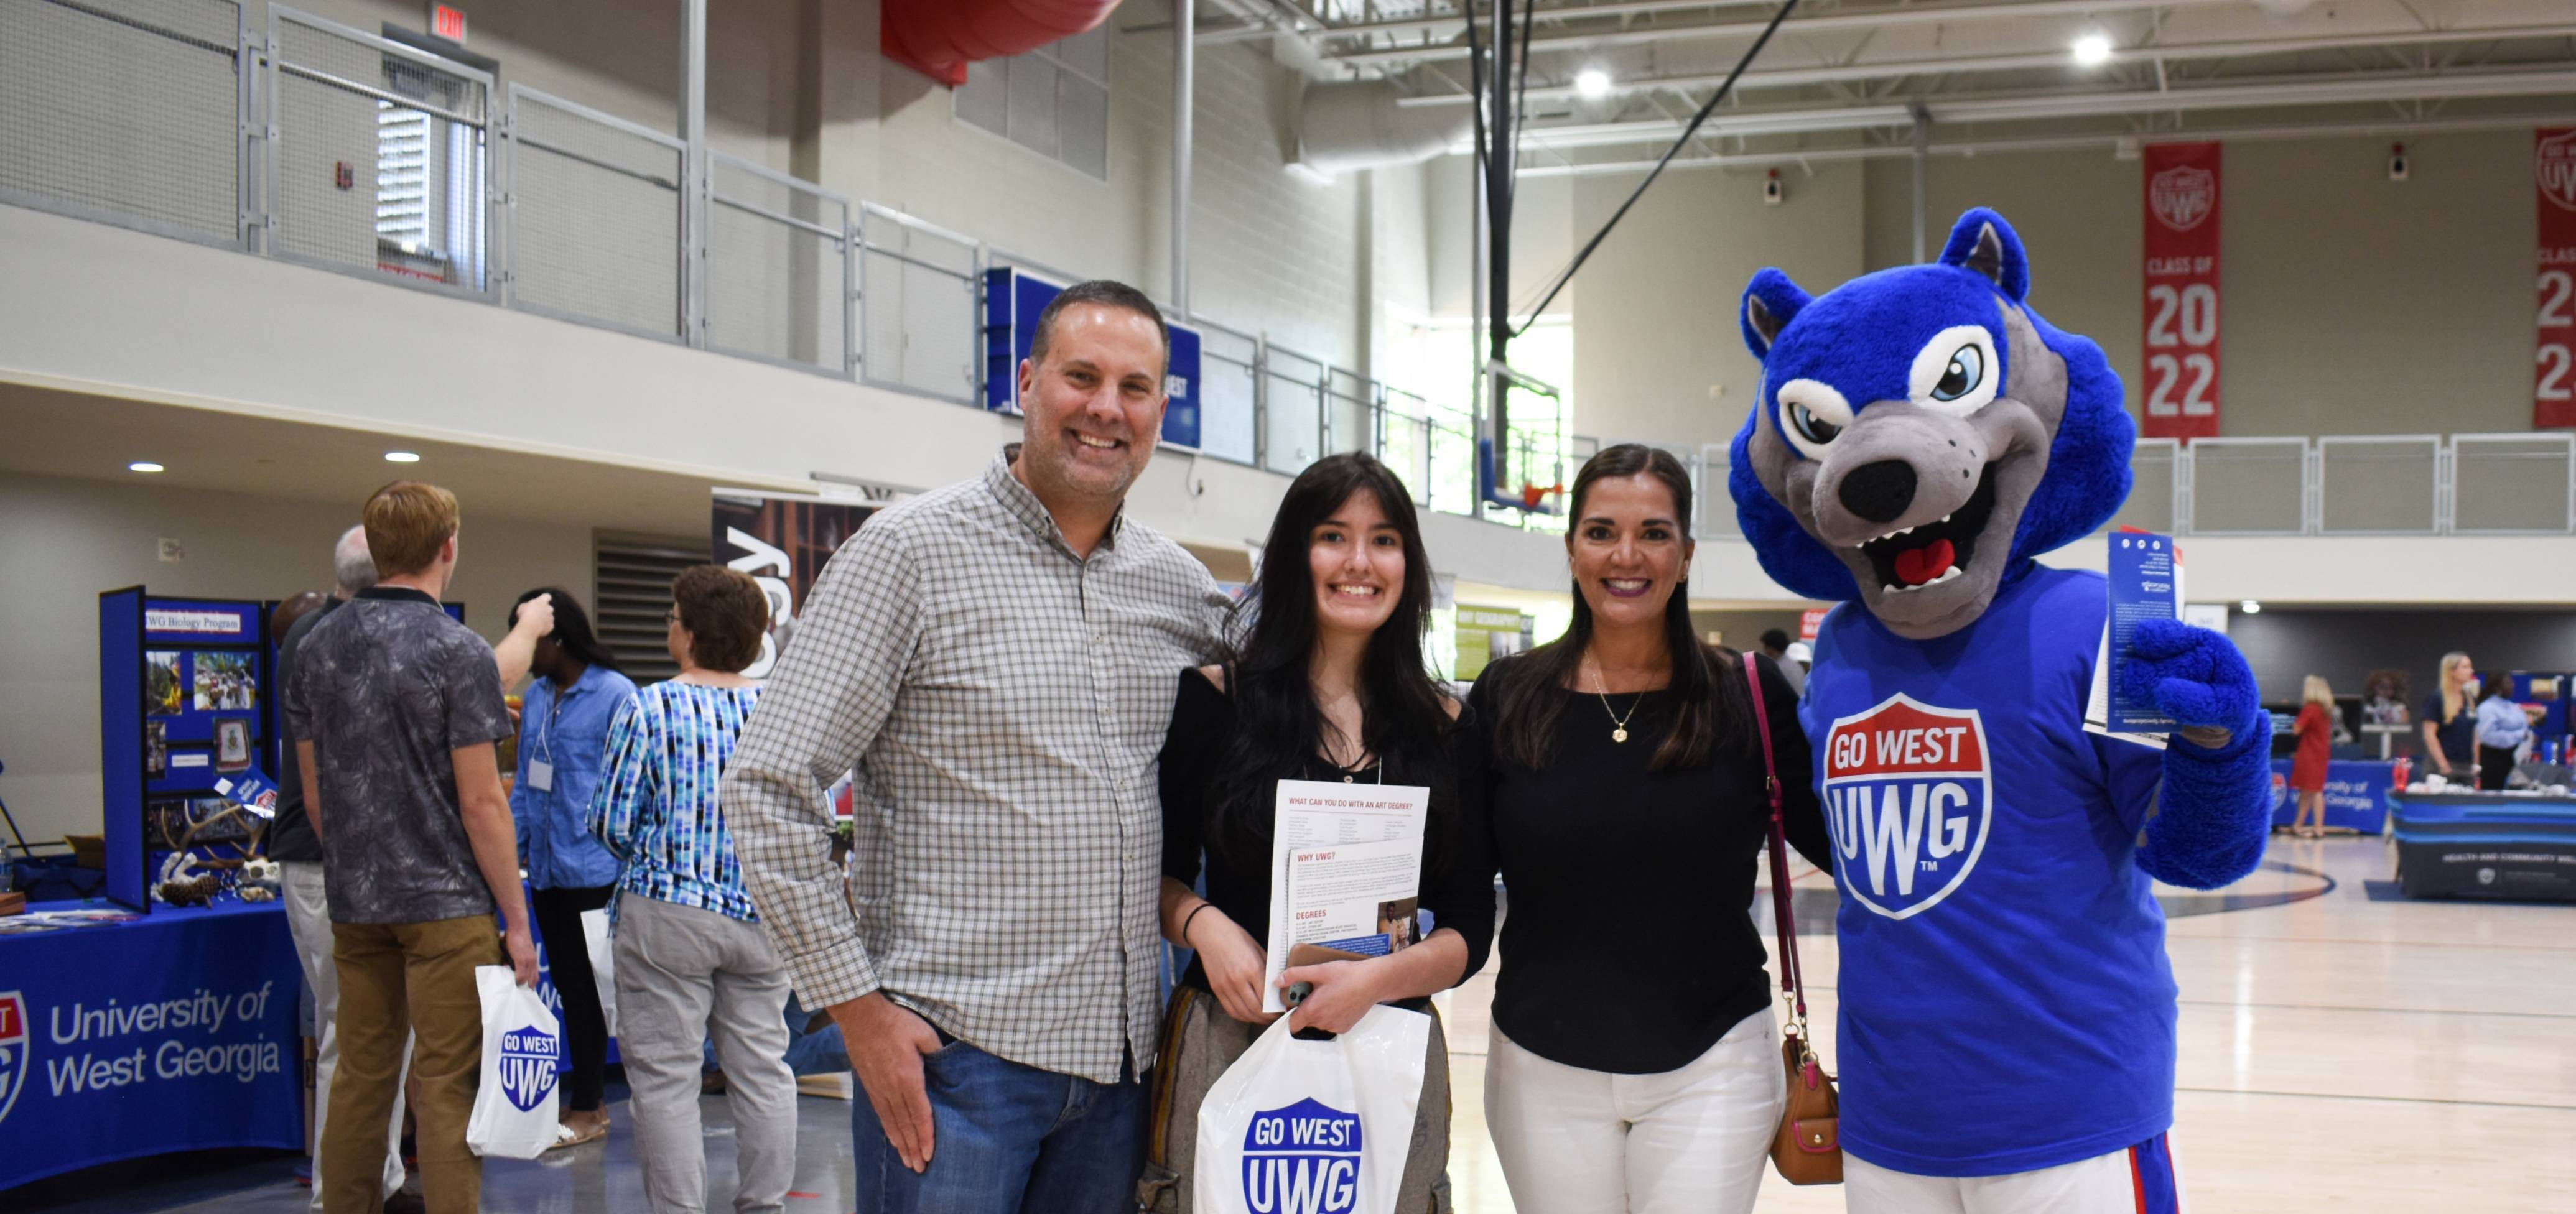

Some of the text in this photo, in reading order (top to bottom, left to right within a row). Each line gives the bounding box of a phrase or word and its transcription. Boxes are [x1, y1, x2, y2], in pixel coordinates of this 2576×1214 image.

[437, 5, 463, 40] EXIT
[2147, 256, 2213, 276] CLASS OF
[2148, 284, 2216, 347] 20
[2537, 271, 2576, 327] 2
[2148, 354, 2214, 416] 22
[2537, 343, 2576, 400] 2
[169, 616, 200, 630] Biology
[203, 618, 238, 629] Program
[1834, 726, 1967, 769] GO WEST
[1288, 797, 1307, 805] WHAT
[1375, 801, 1387, 809] ART
[1388, 802, 1413, 810] DEGREE?
[1297, 852, 1336, 862] WHY UWG?
[1832, 782, 1969, 896] UWG
[1921, 861, 1938, 871] TM
[1296, 909, 1327, 920] DEGREES
[51, 981, 272, 1045] University of
[47, 1047, 146, 1096] West
[155, 1032, 279, 1082] Georgia
[504, 1034, 555, 1054] GO WEST
[503, 1058, 556, 1106] UWG
[1255, 1118, 1355, 1146] GO WEST
[1250, 1158, 1354, 1214] UWG
